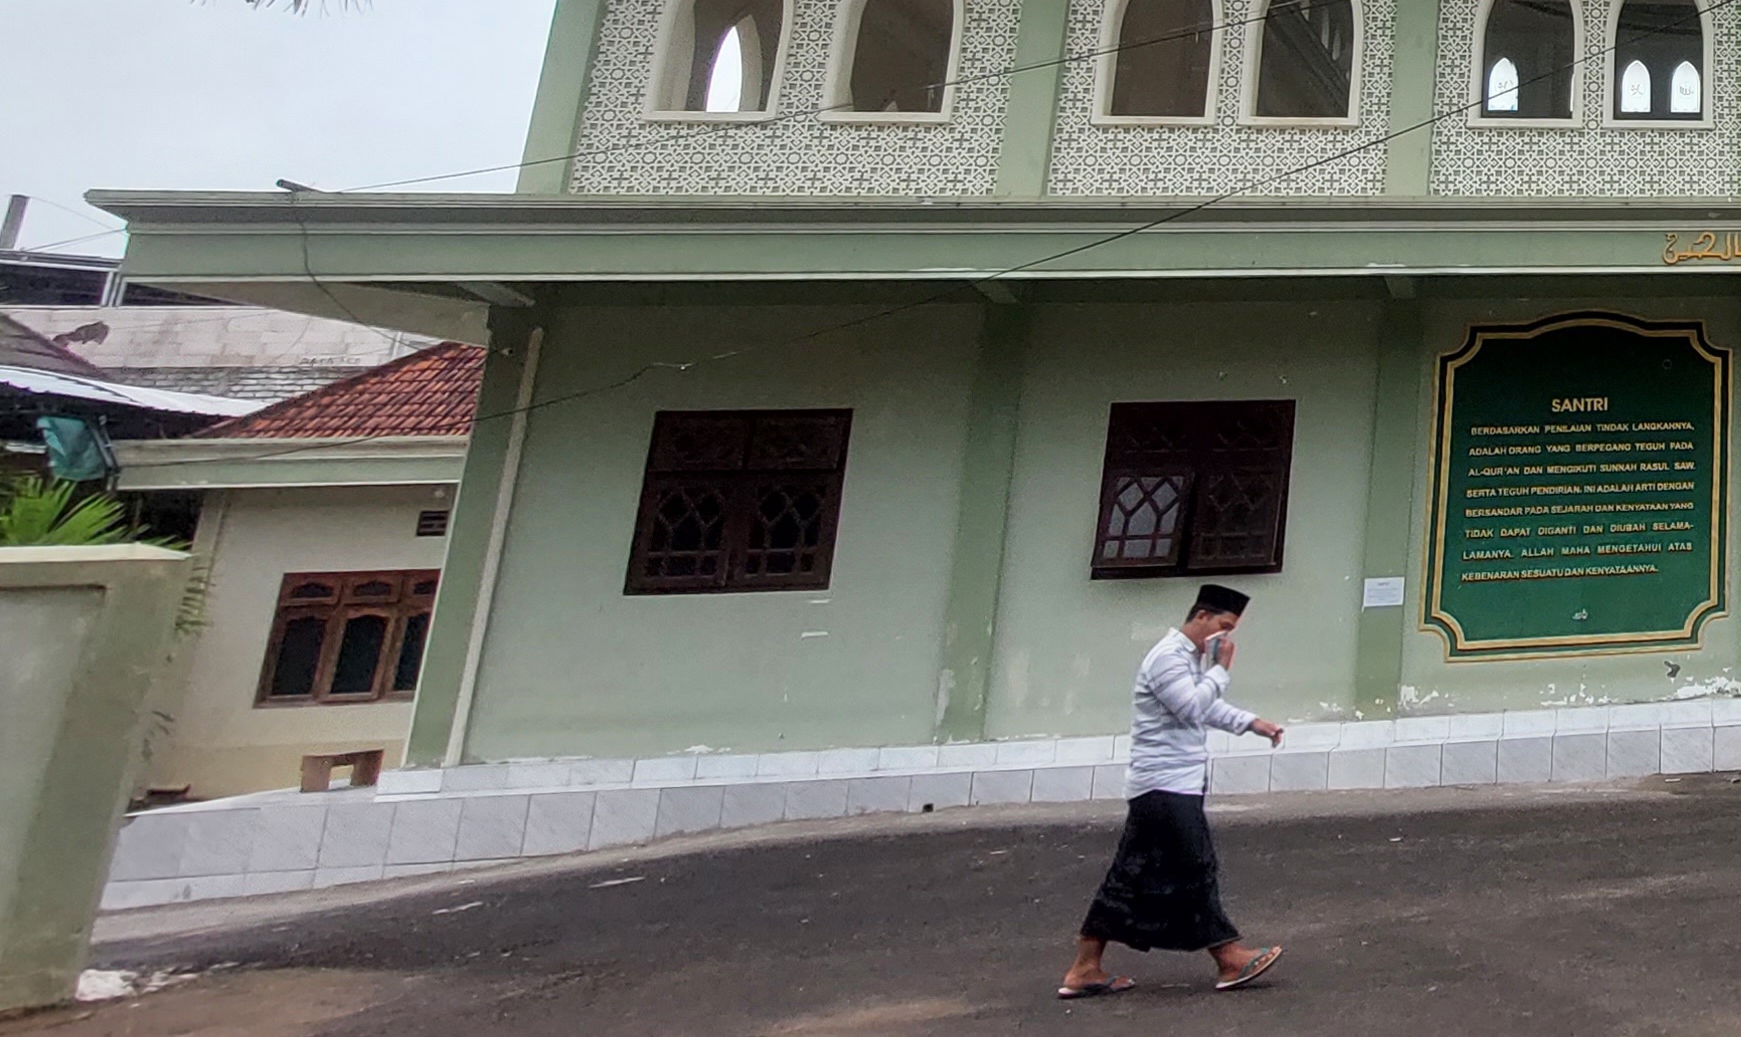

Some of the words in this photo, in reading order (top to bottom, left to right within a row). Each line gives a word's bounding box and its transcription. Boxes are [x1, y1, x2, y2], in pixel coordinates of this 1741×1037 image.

[1551, 397, 1609, 413] SANTRI
[1471, 425, 1540, 436] BERDASARKAN
[1544, 424, 1592, 434] PENILAIAN
[1596, 422, 1629, 432] TINDAK
[1632, 421, 1695, 432] LANGKAHNYA,
[1468, 446, 1507, 457] ADALAH
[1508, 445, 1542, 455] ORANG
[1546, 444, 1571, 454] YANG
[1575, 443, 1632, 453] BERPEGANG
[1635, 442, 1666, 452] TEGUH
[1670, 441, 1694, 451] PADA
[1468, 466, 1520, 477] AL-QUR'AN
[1523, 465, 1543, 475] DAN
[1547, 464, 1597, 474] MENGIKUTI
[1600, 463, 1637, 473] SUNNAH
[1640, 462, 1670, 471] RASUL
[1674, 461, 1696, 470] SAW.
[1466, 488, 1497, 498] SERTA
[1498, 487, 1529, 497] TEGUH
[1531, 486, 1582, 495] PENDIRIAN.
[1584, 484, 1596, 494] INI
[1596, 483, 1634, 493] ADALAH
[1635, 482, 1656, 492] ARTI
[1657, 481, 1694, 491] DENGAN
[1465, 507, 1523, 518] BERSANDAR
[1524, 506, 1549, 515] PADA
[1551, 504, 1594, 514] SEJARAH
[1595, 503, 1614, 513] DAN
[1616, 502, 1669, 512] KENYATAAN
[1670, 501, 1694, 510] YANG
[1465, 529, 1494, 539] TIDAK
[1500, 527, 1530, 537] DAPAT
[1538, 526, 1576, 536] DIGANTI
[1583, 524, 1603, 534] DAN
[1610, 522, 1646, 532] DIUBAH
[1652, 521, 1694, 531] SELAMA-
[1462, 550, 1514, 560] LAMANYA.
[1521, 547, 1554, 557] ALLAH
[1561, 545, 1591, 555] MAHA
[1597, 543, 1661, 553] MENGETAHUI
[1667, 542, 1692, 551] ATAS
[1461, 571, 1520, 582] KEBENARAN
[1520, 568, 1565, 578] SESUATU
[1565, 567, 1585, 576] DAN
[1585, 564, 1659, 575] KENYATAANNYA.
